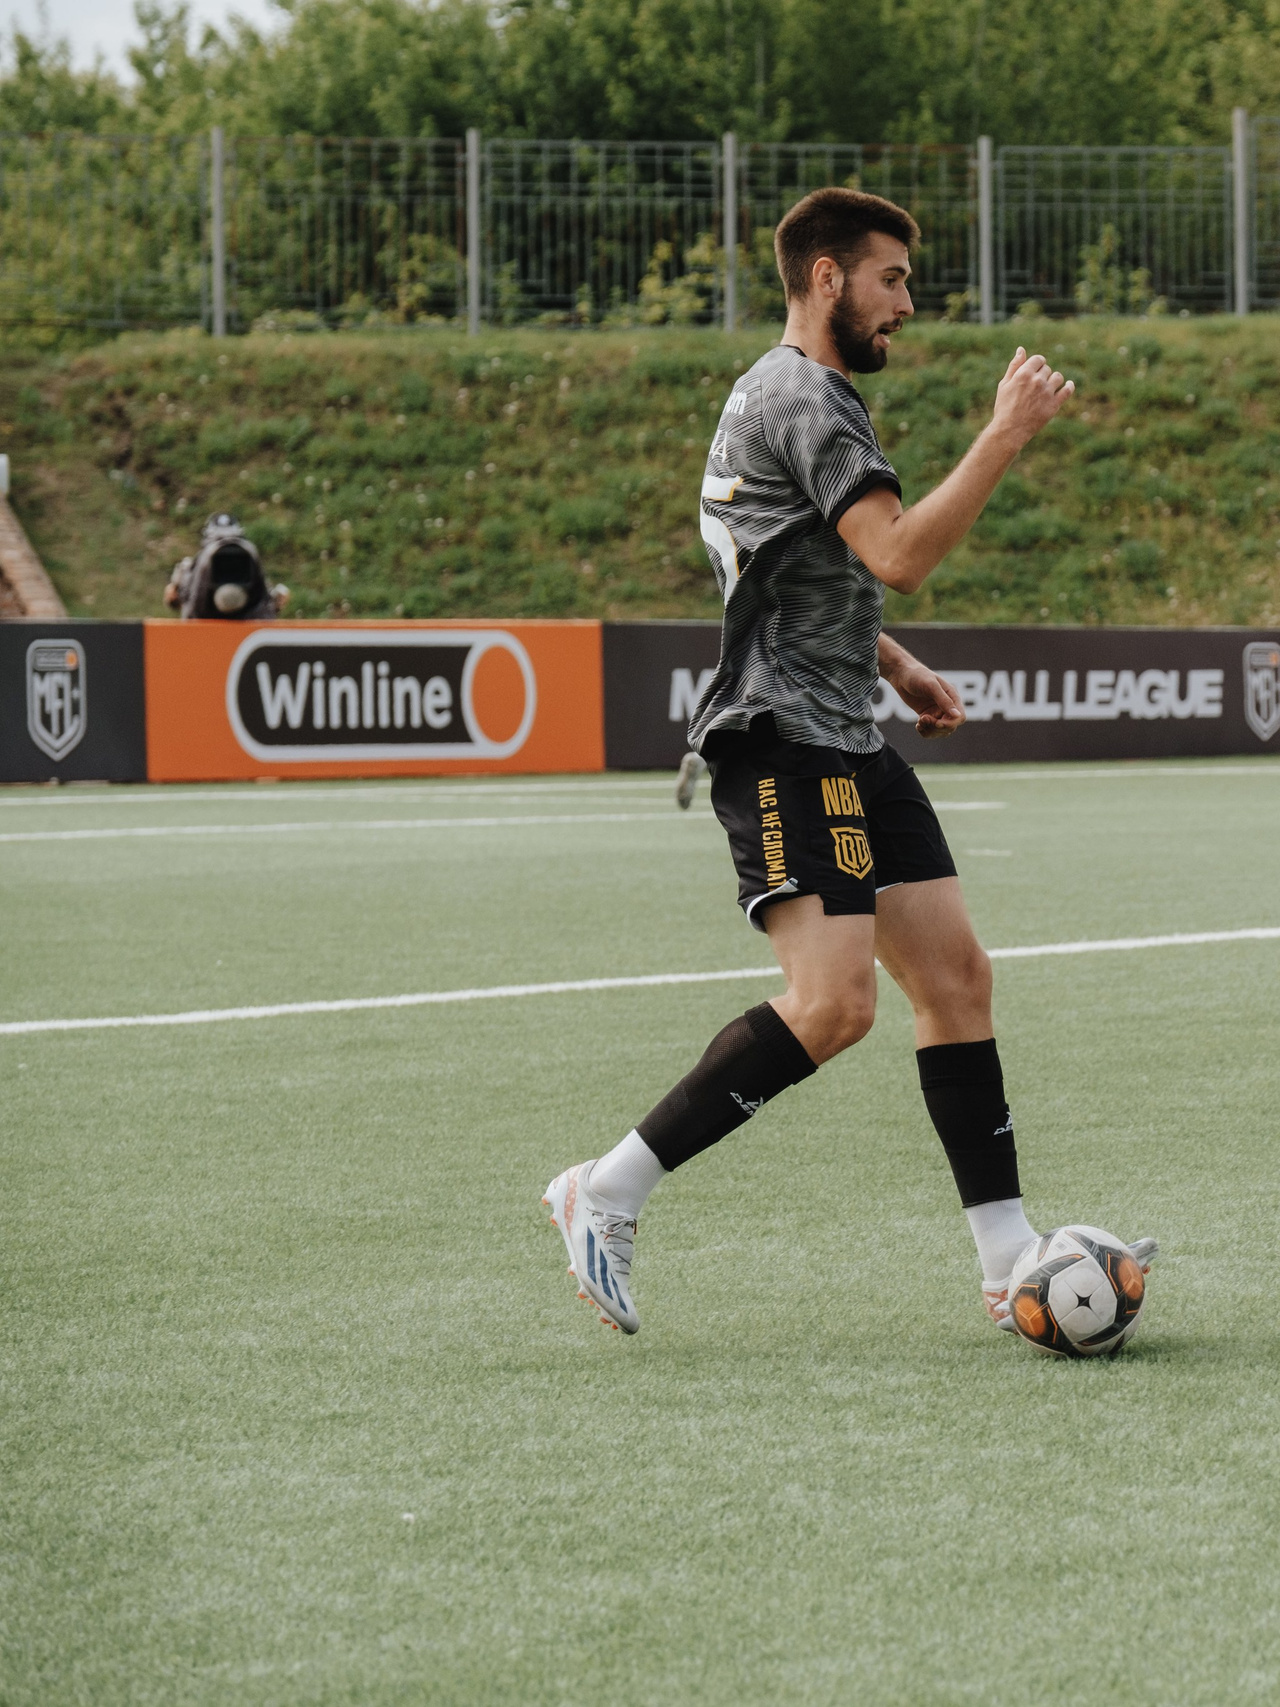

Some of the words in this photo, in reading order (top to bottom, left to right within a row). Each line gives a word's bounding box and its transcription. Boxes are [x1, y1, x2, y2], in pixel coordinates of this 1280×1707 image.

[256, 661, 453, 730] Winline
[1062, 668, 1224, 721] LEAGUE
[758, 777, 777, 808] НАС
[762, 830, 787, 894] СЛОМАТ
